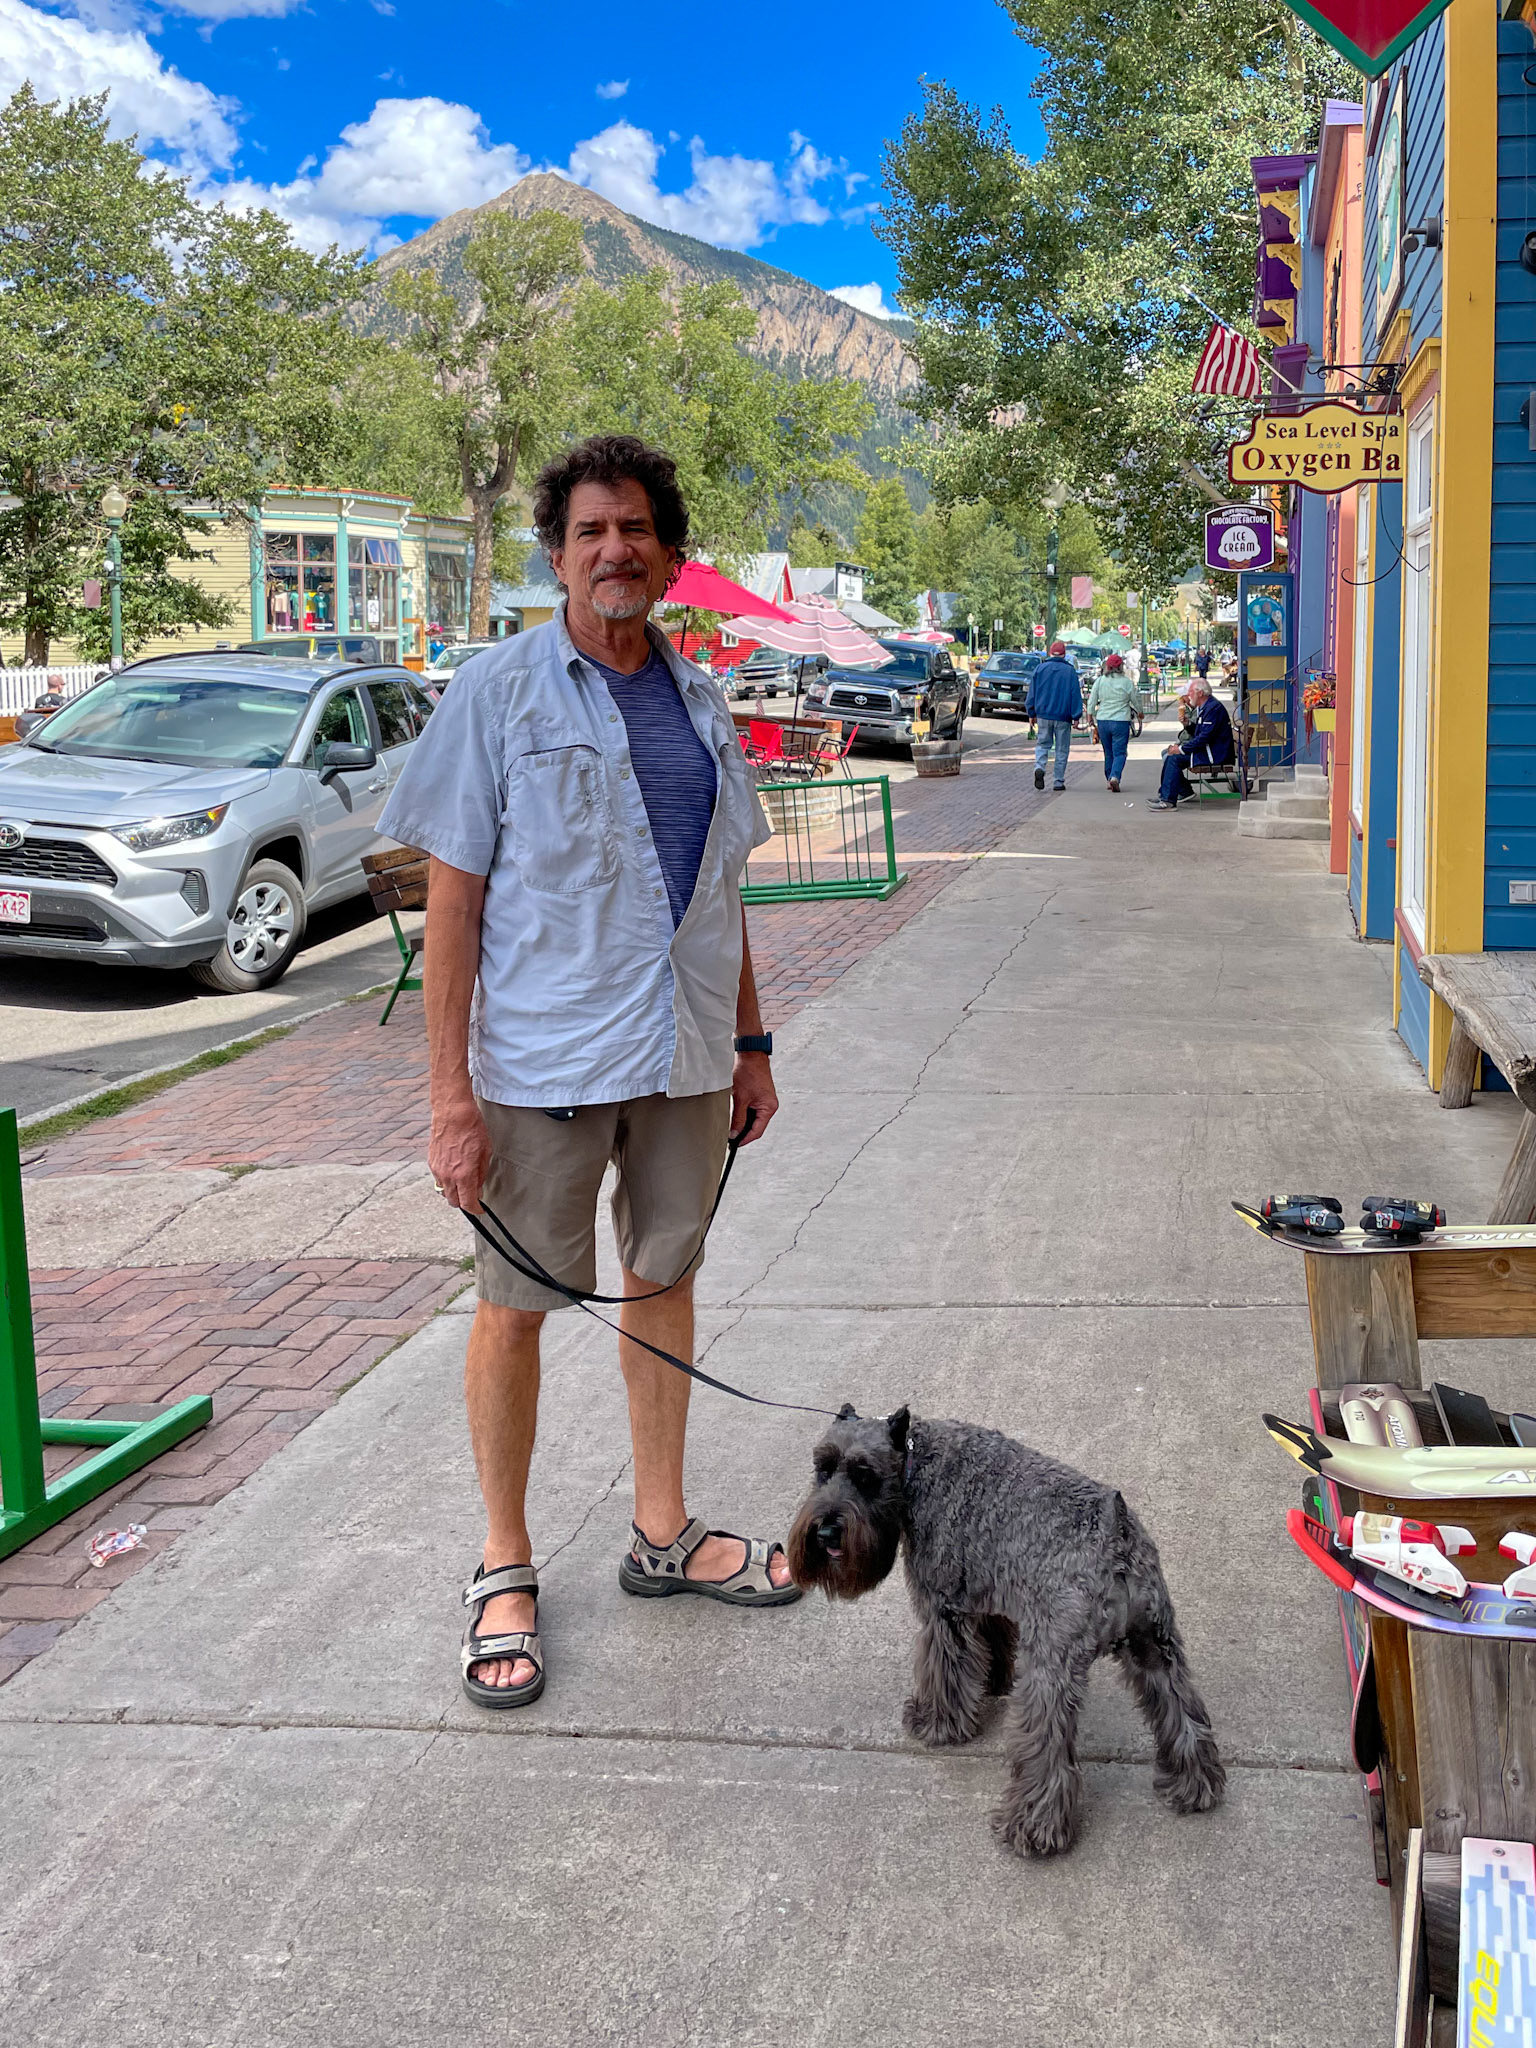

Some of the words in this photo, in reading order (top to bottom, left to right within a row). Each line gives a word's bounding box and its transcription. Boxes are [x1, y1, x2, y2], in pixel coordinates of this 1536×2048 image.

[1266, 423, 1298, 439] Sea
[1305, 422, 1356, 438] Level
[1362, 421, 1399, 441] Spa
[1242, 447, 1351, 477] Oxygen
[1361, 447, 1401, 471] Ba
[1211, 516, 1242, 526] CHOCOLATE
[1243, 515, 1268, 525] FACTORY
[1233, 532, 1246, 541] ICE
[1224, 543, 1255, 552] CREAM
